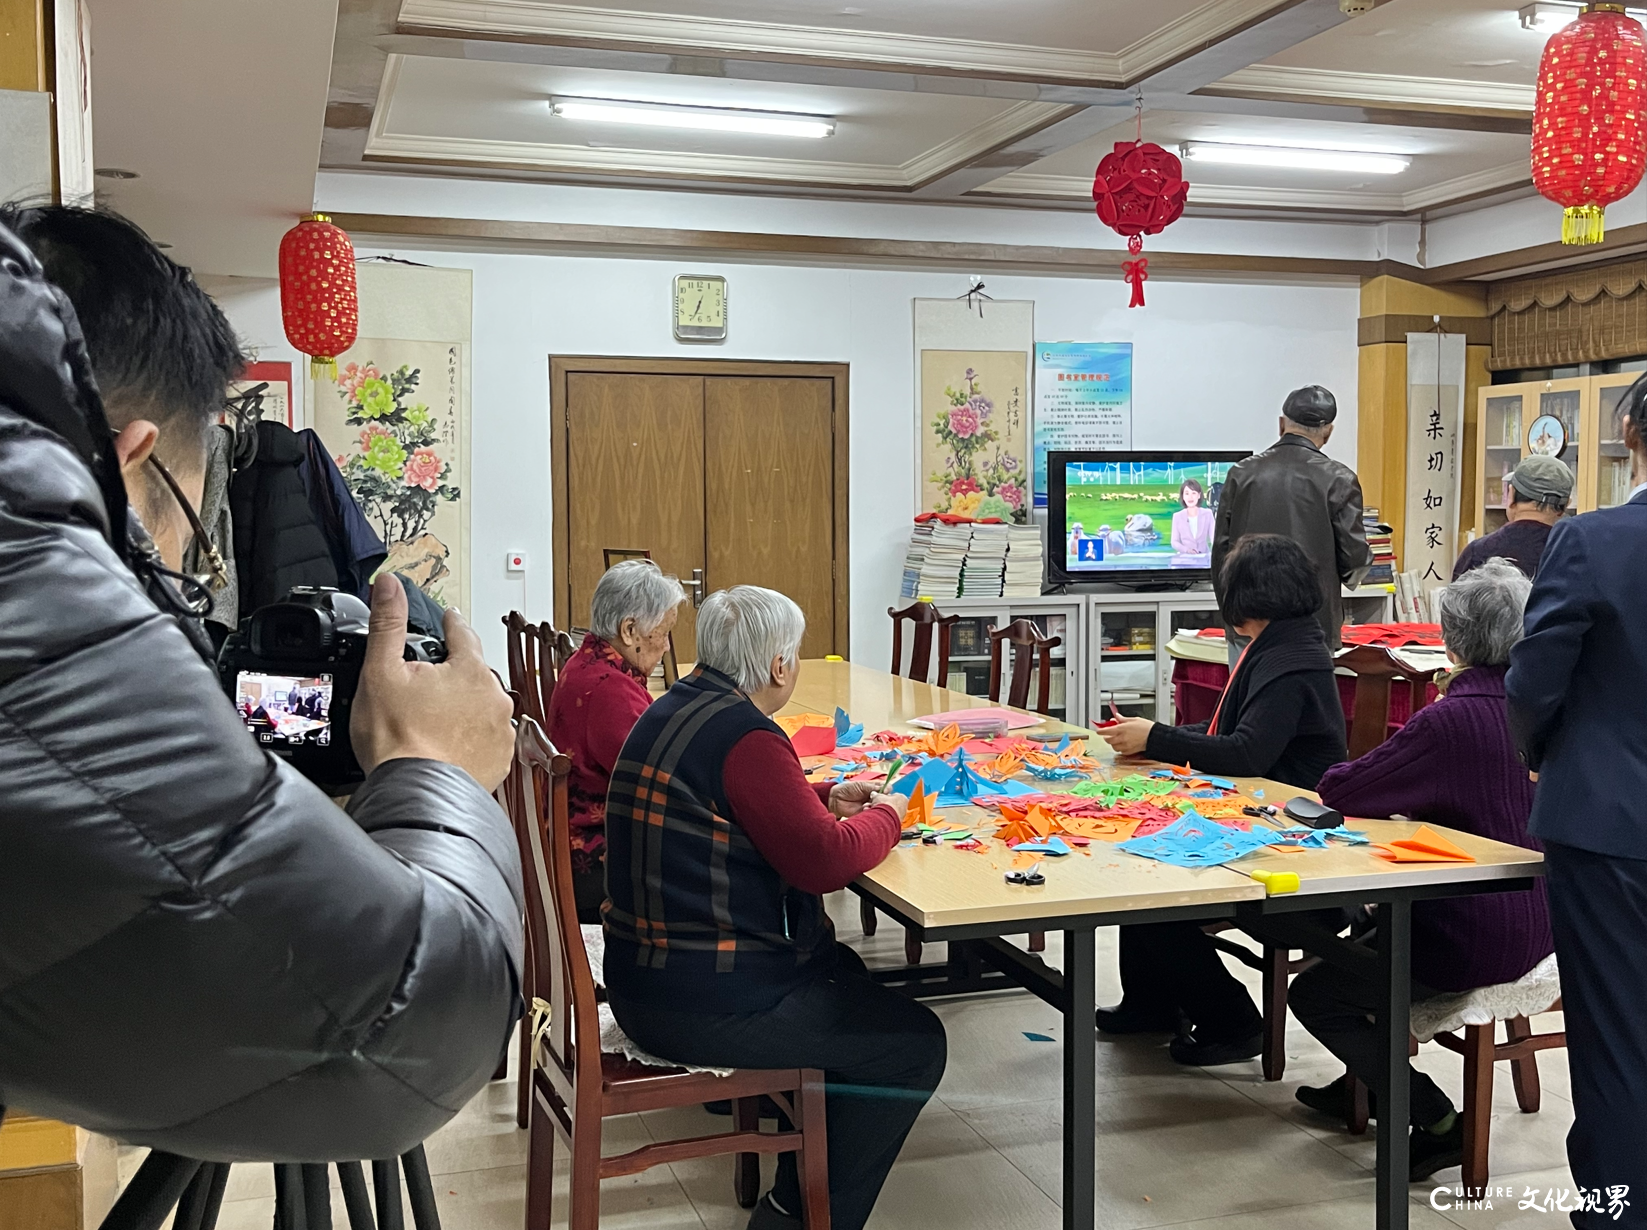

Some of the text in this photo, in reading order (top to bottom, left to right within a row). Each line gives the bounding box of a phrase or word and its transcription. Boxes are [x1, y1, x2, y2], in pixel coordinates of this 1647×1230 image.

[696, 281, 704, 289] 12
[697, 315, 703, 323] 6
[1421, 409, 1445, 581] 亲切如家人
